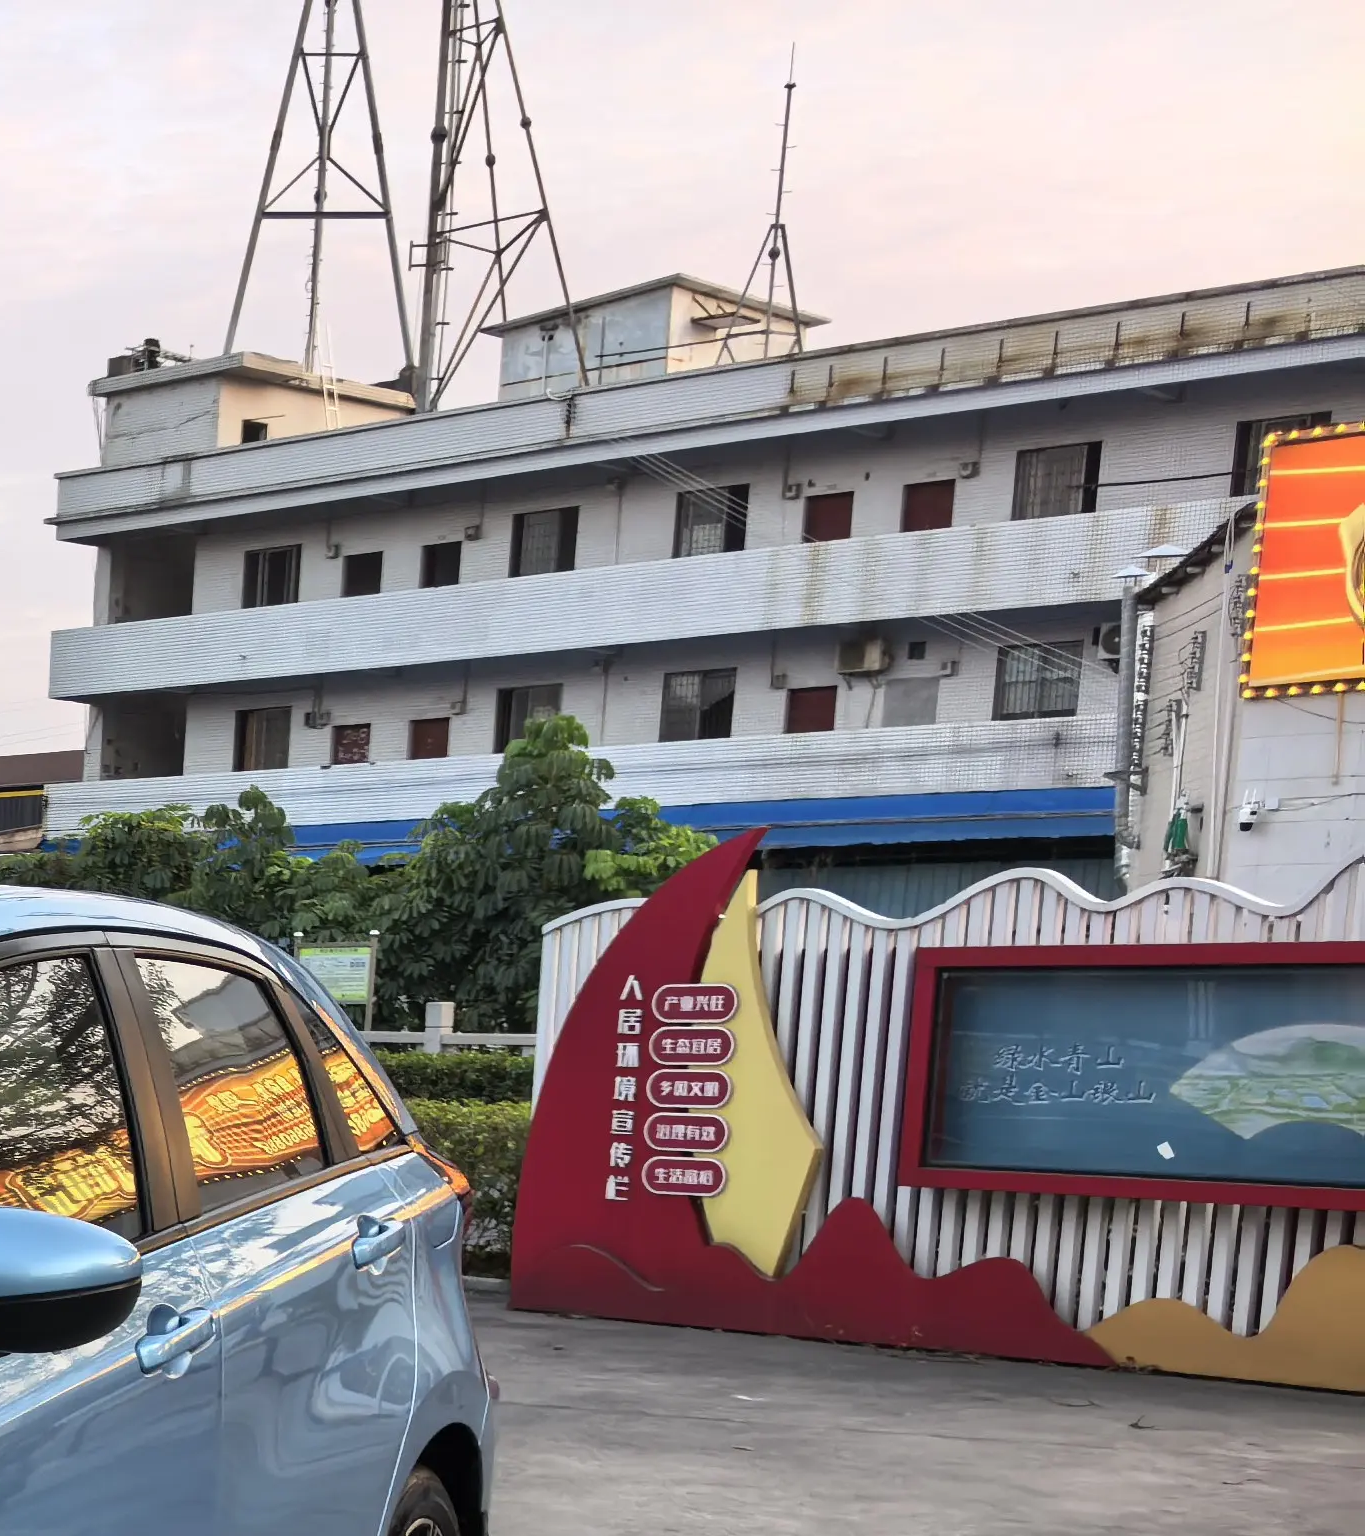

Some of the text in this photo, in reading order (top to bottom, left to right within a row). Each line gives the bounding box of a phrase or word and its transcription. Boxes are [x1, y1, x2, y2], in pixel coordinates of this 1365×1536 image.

[604, 974, 643, 1201] 人居环境宣传栏
[660, 1038, 722, 1054] 生态宜居
